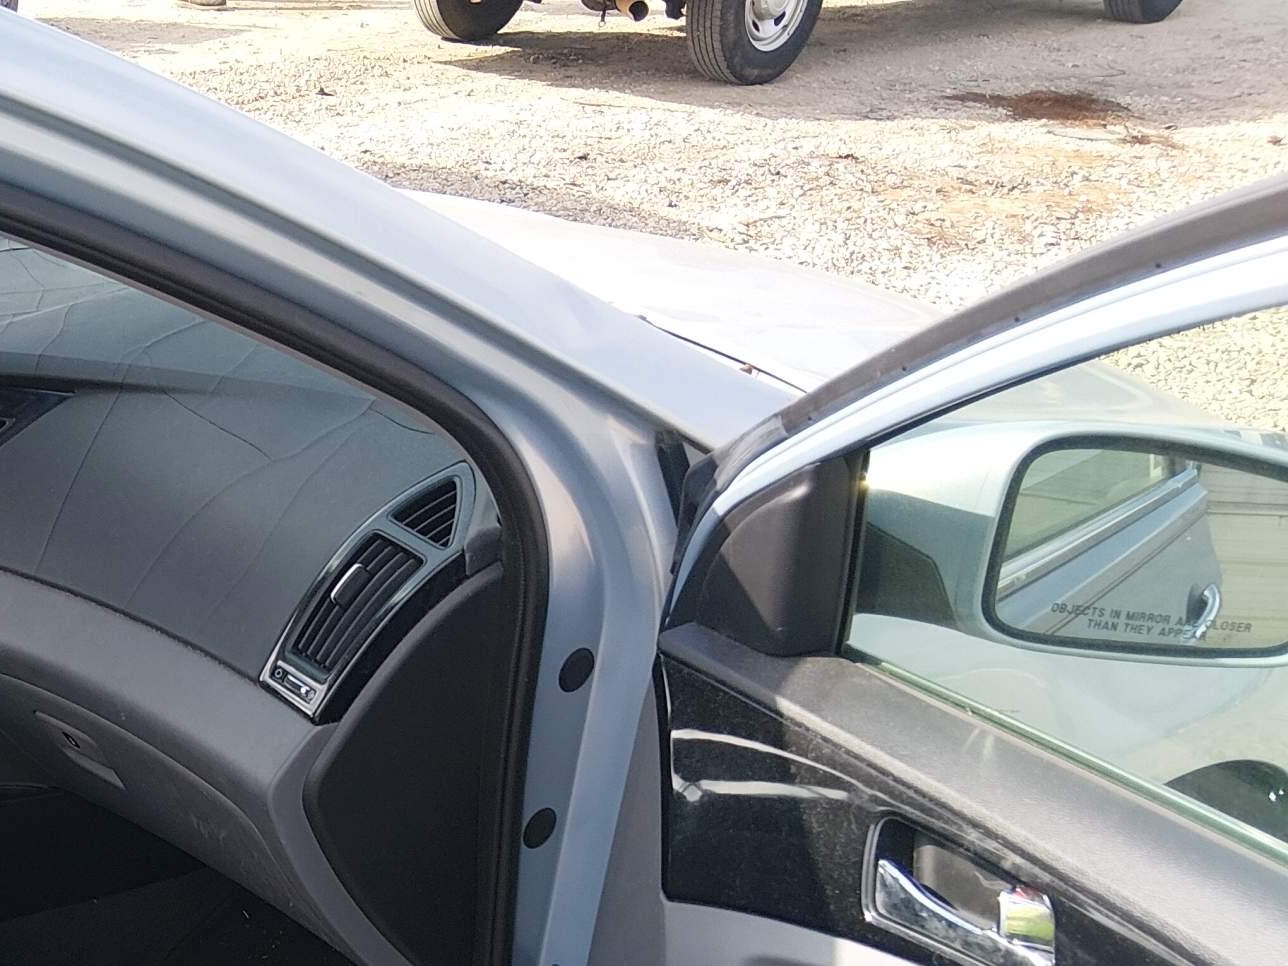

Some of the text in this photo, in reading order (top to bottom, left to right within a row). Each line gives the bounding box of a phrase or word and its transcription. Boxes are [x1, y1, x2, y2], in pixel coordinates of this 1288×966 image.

[1051, 602, 1105, 618] OBJECTS
[1111, 609, 1122, 620] IN
[1126, 610, 1171, 624] MIRROR
[1088, 618, 1120, 632] THAN
[1124, 622, 1154, 635] THEY
